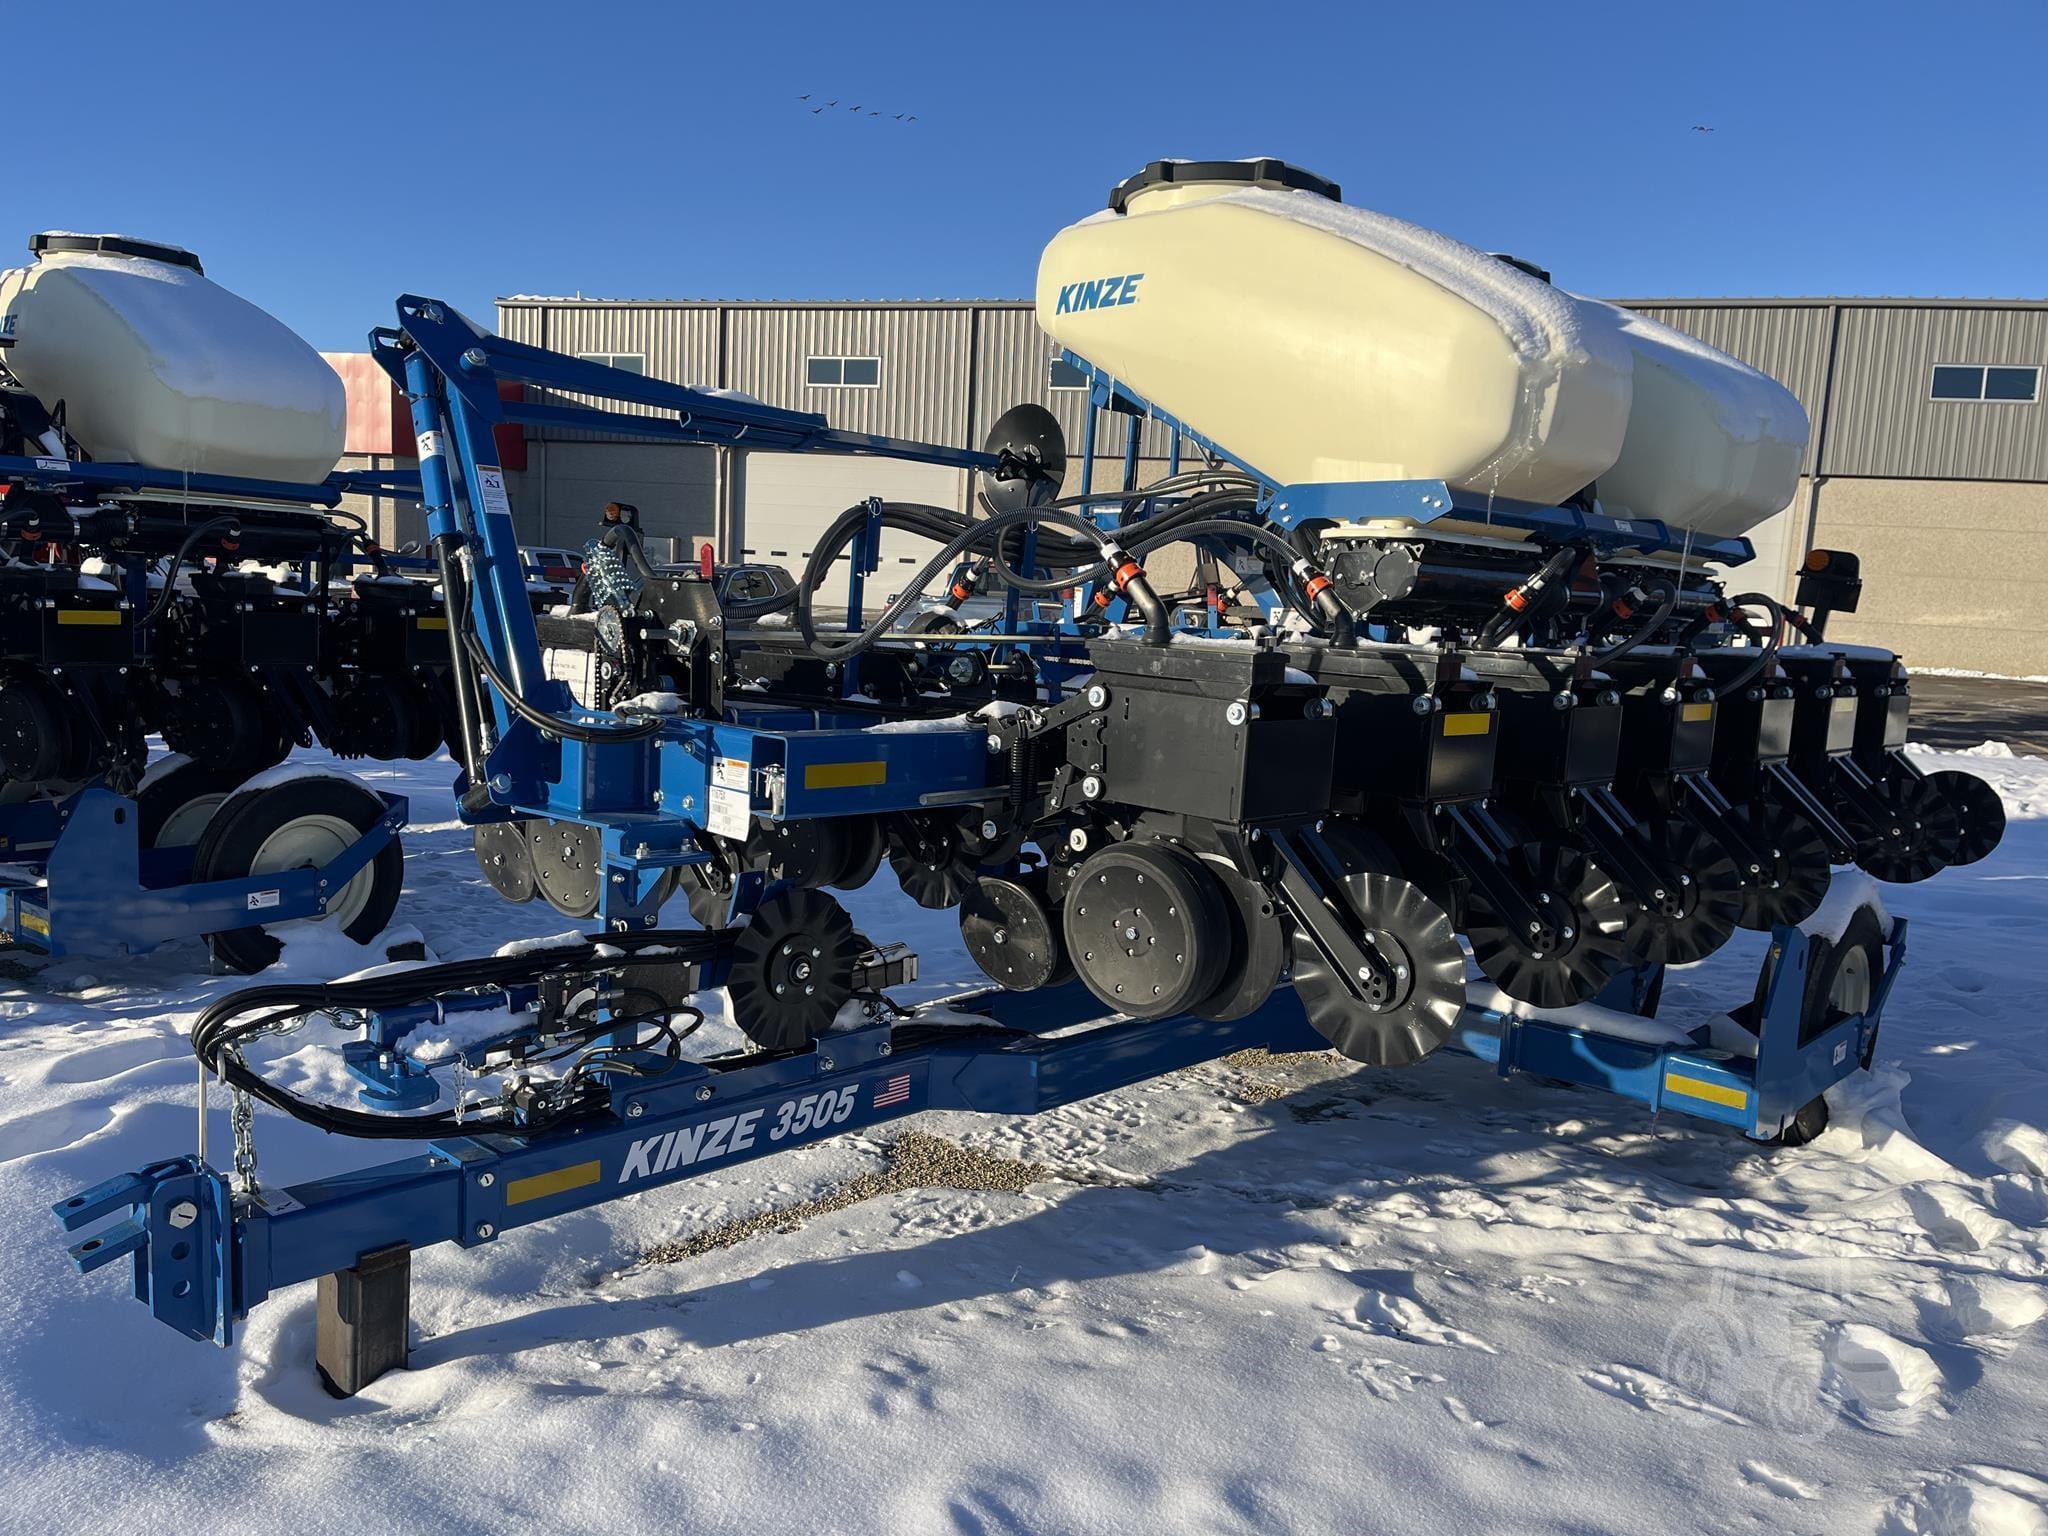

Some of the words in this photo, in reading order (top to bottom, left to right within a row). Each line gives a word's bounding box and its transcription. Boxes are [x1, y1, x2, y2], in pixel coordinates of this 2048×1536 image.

[1055, 273, 1145, 316] KINZE
[618, 1108, 765, 1184] KINZE
[769, 1084, 859, 1141] 3505
